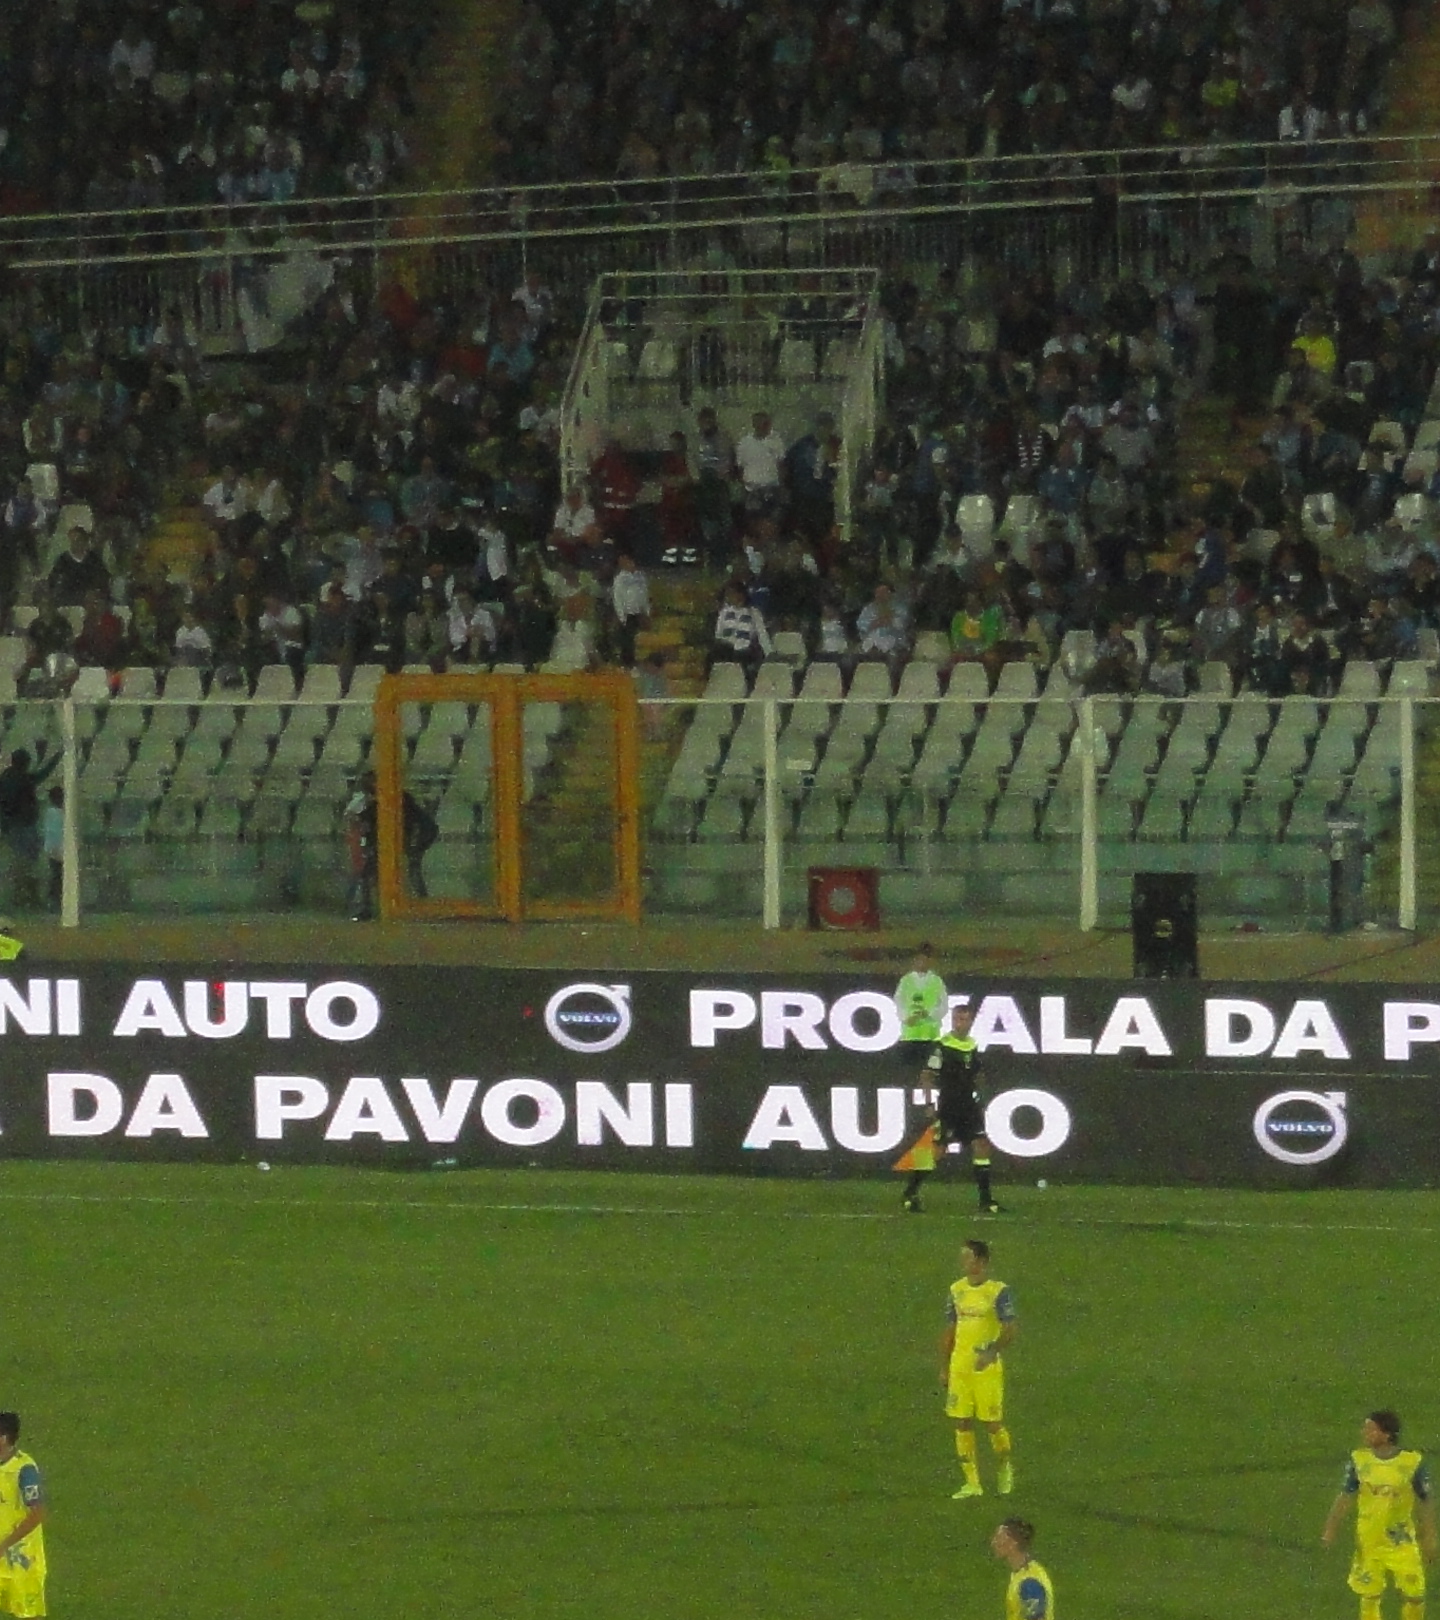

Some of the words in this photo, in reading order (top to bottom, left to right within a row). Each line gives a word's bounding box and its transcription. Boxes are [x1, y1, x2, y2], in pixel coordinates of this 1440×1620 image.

[114, 980, 379, 1041] AUTO
[1205, 999, 1350, 1060] DA
[48, 1073, 208, 1138] DA
[255, 1076, 693, 1148] PAVONI
